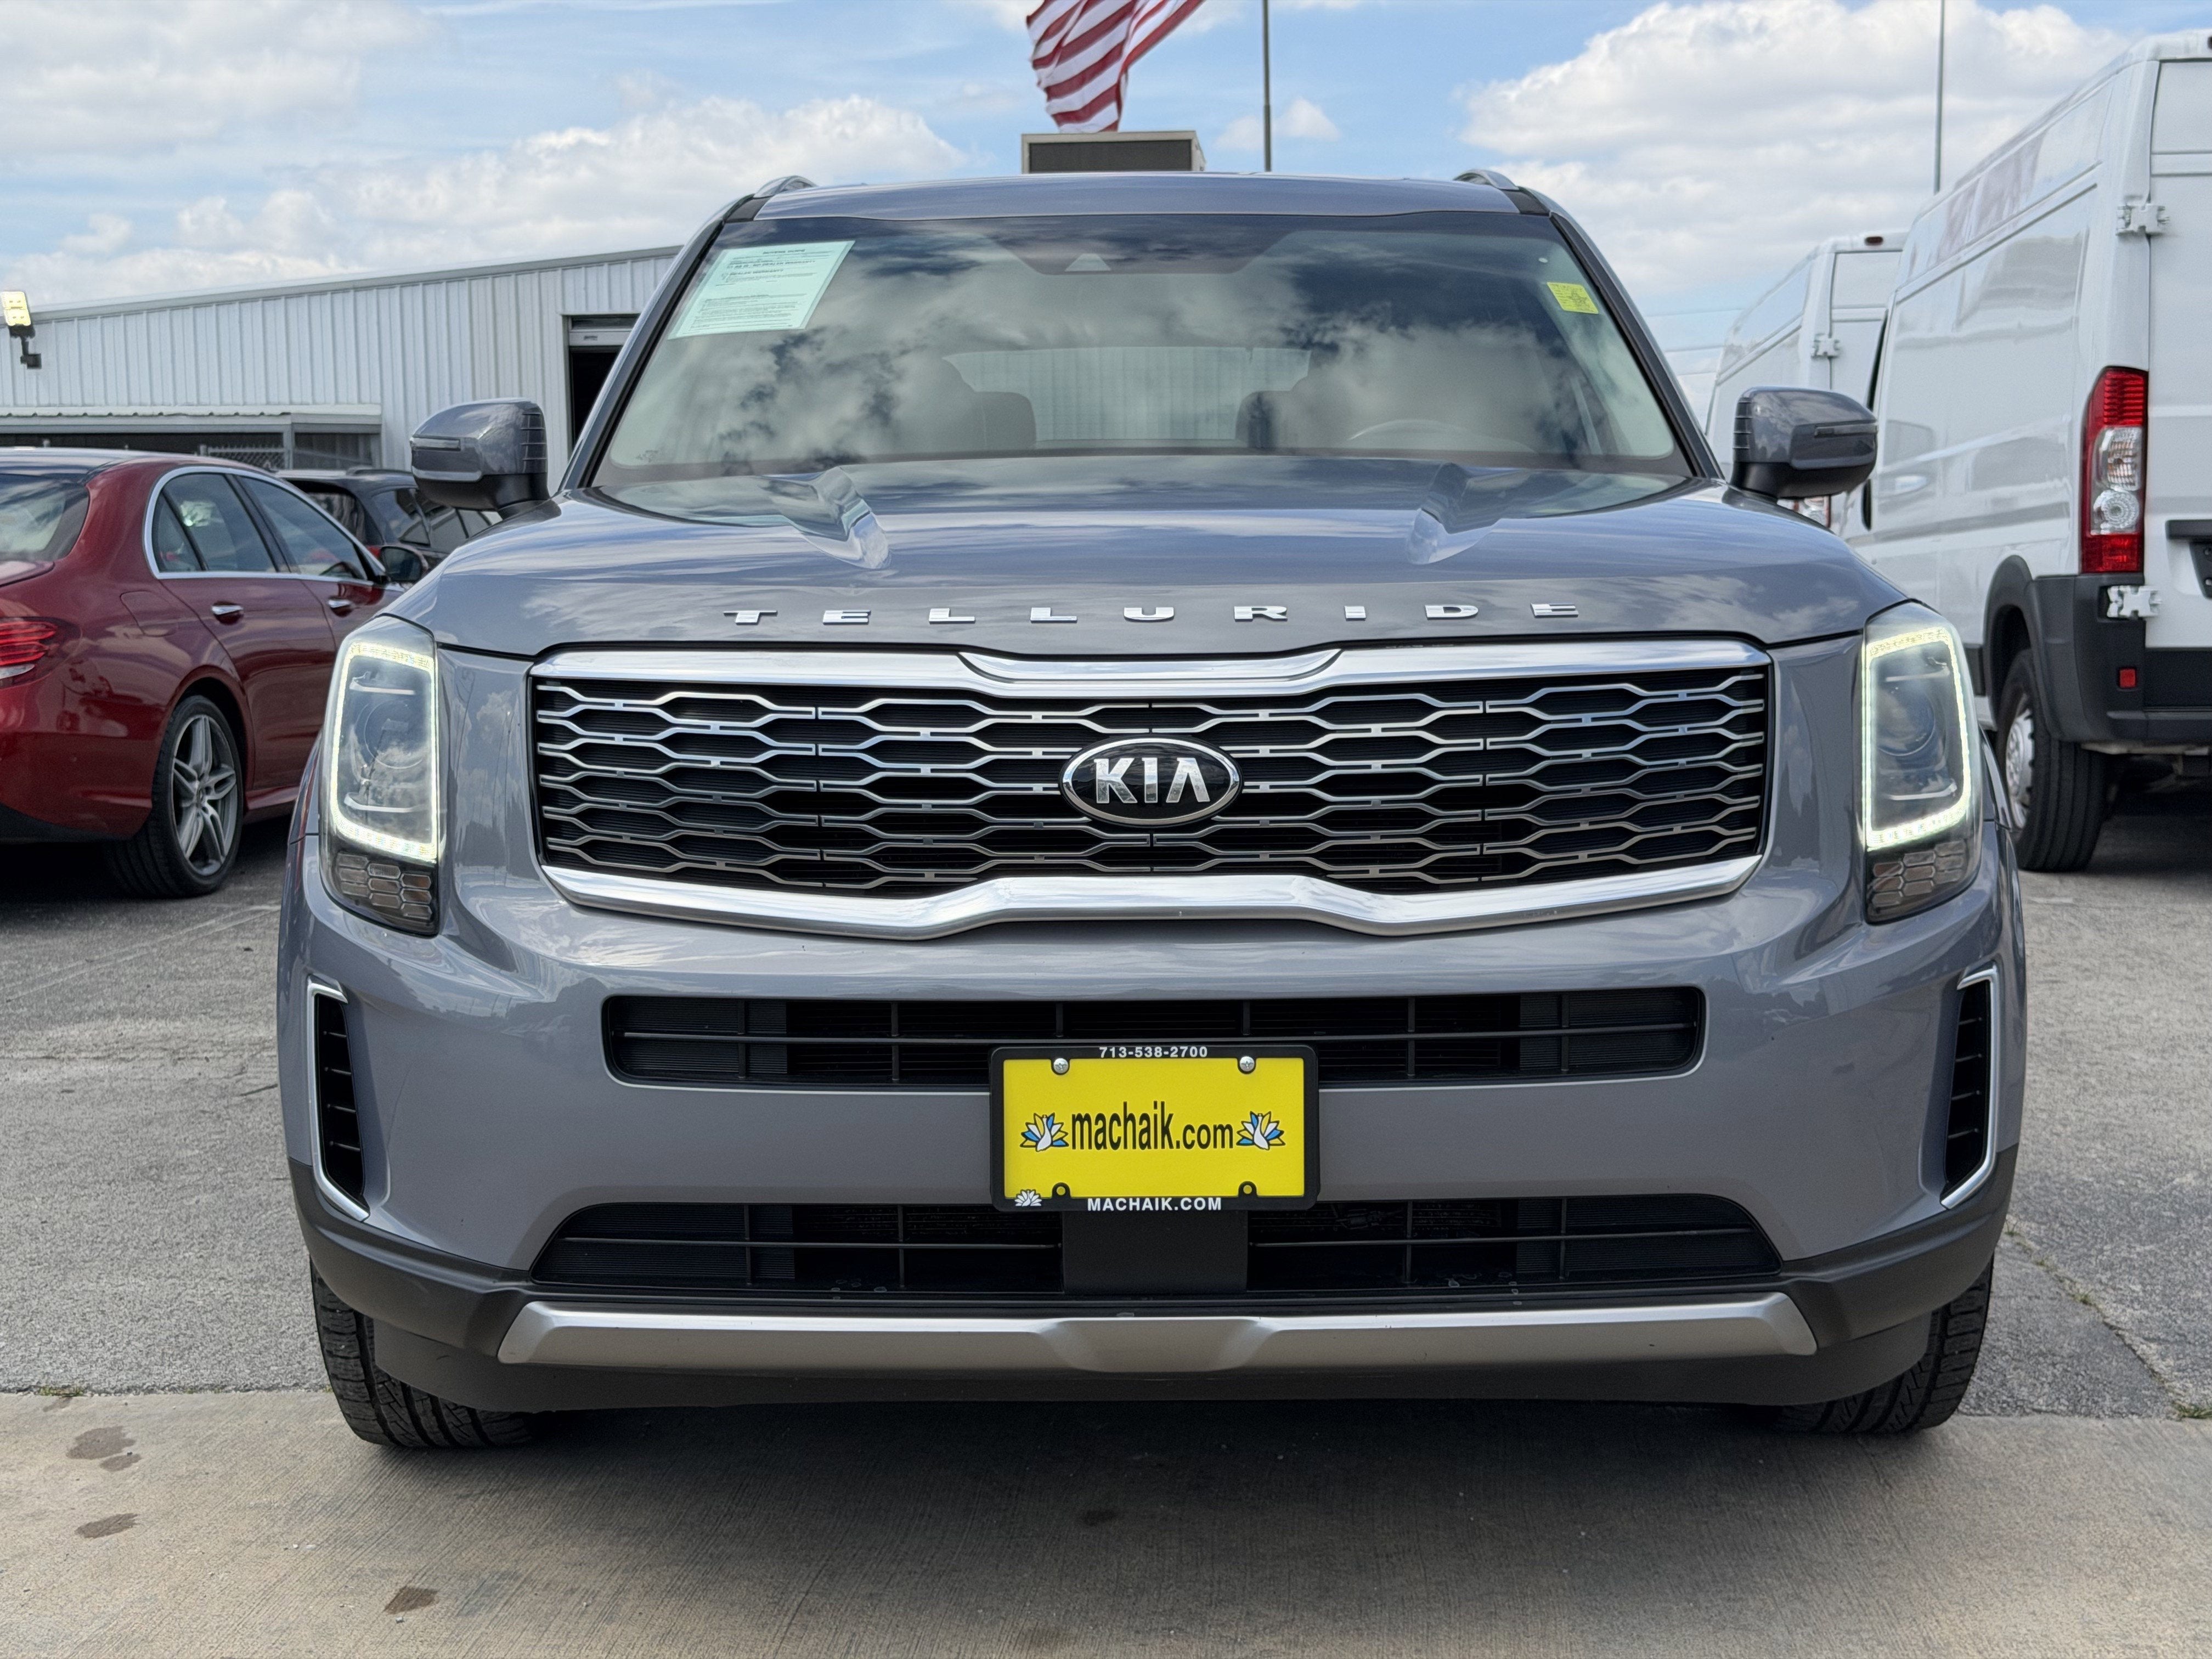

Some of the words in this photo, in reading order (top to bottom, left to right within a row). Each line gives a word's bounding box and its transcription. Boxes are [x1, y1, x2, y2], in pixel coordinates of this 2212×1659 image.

[723, 603, 1578, 625] TELLURIDE
[1093, 757, 1210, 804] KIA
[1099, 1046, 1207, 1058] 713-538-2700
[1071, 1100, 1233, 1150] machaik.com
[1087, 1197, 1221, 1211] MACHAIK.COM
